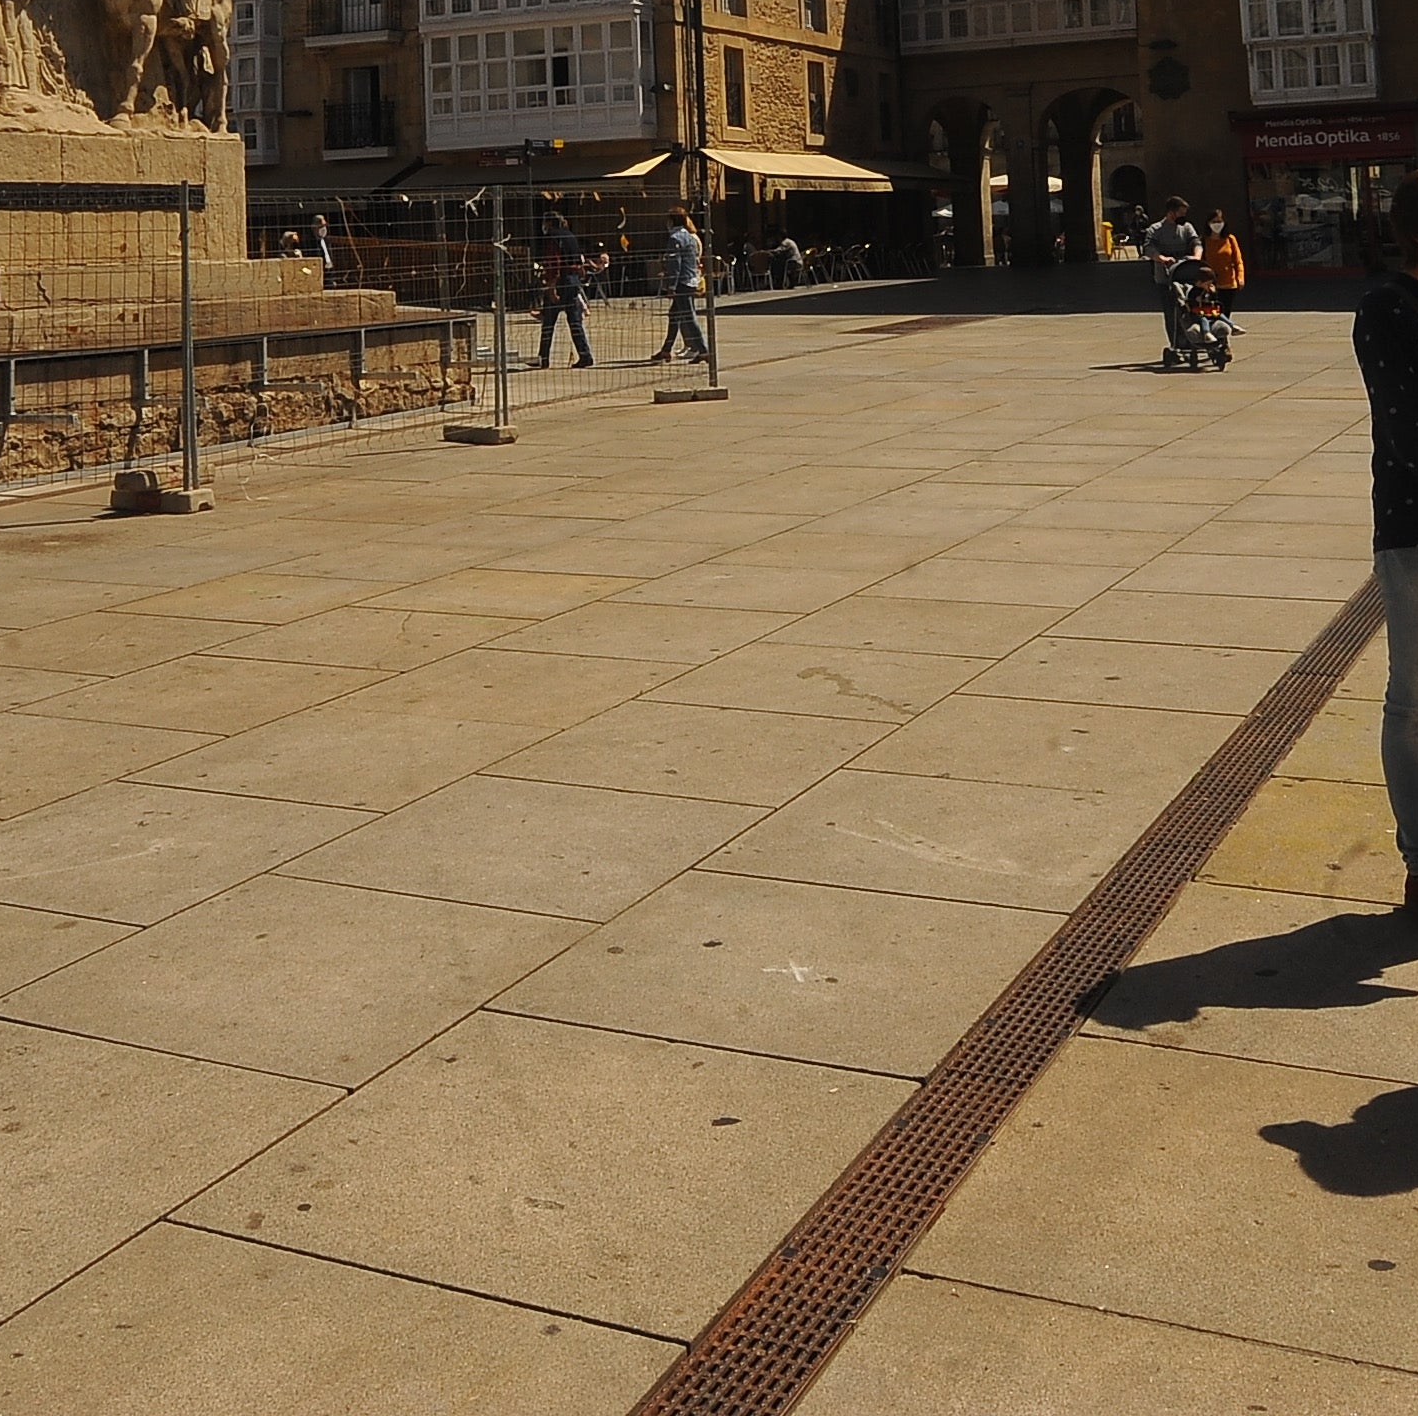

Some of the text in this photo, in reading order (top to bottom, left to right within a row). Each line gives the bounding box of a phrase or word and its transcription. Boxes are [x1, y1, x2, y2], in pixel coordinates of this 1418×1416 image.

[1255, 129, 1401, 148] Mendia Optika 1856
